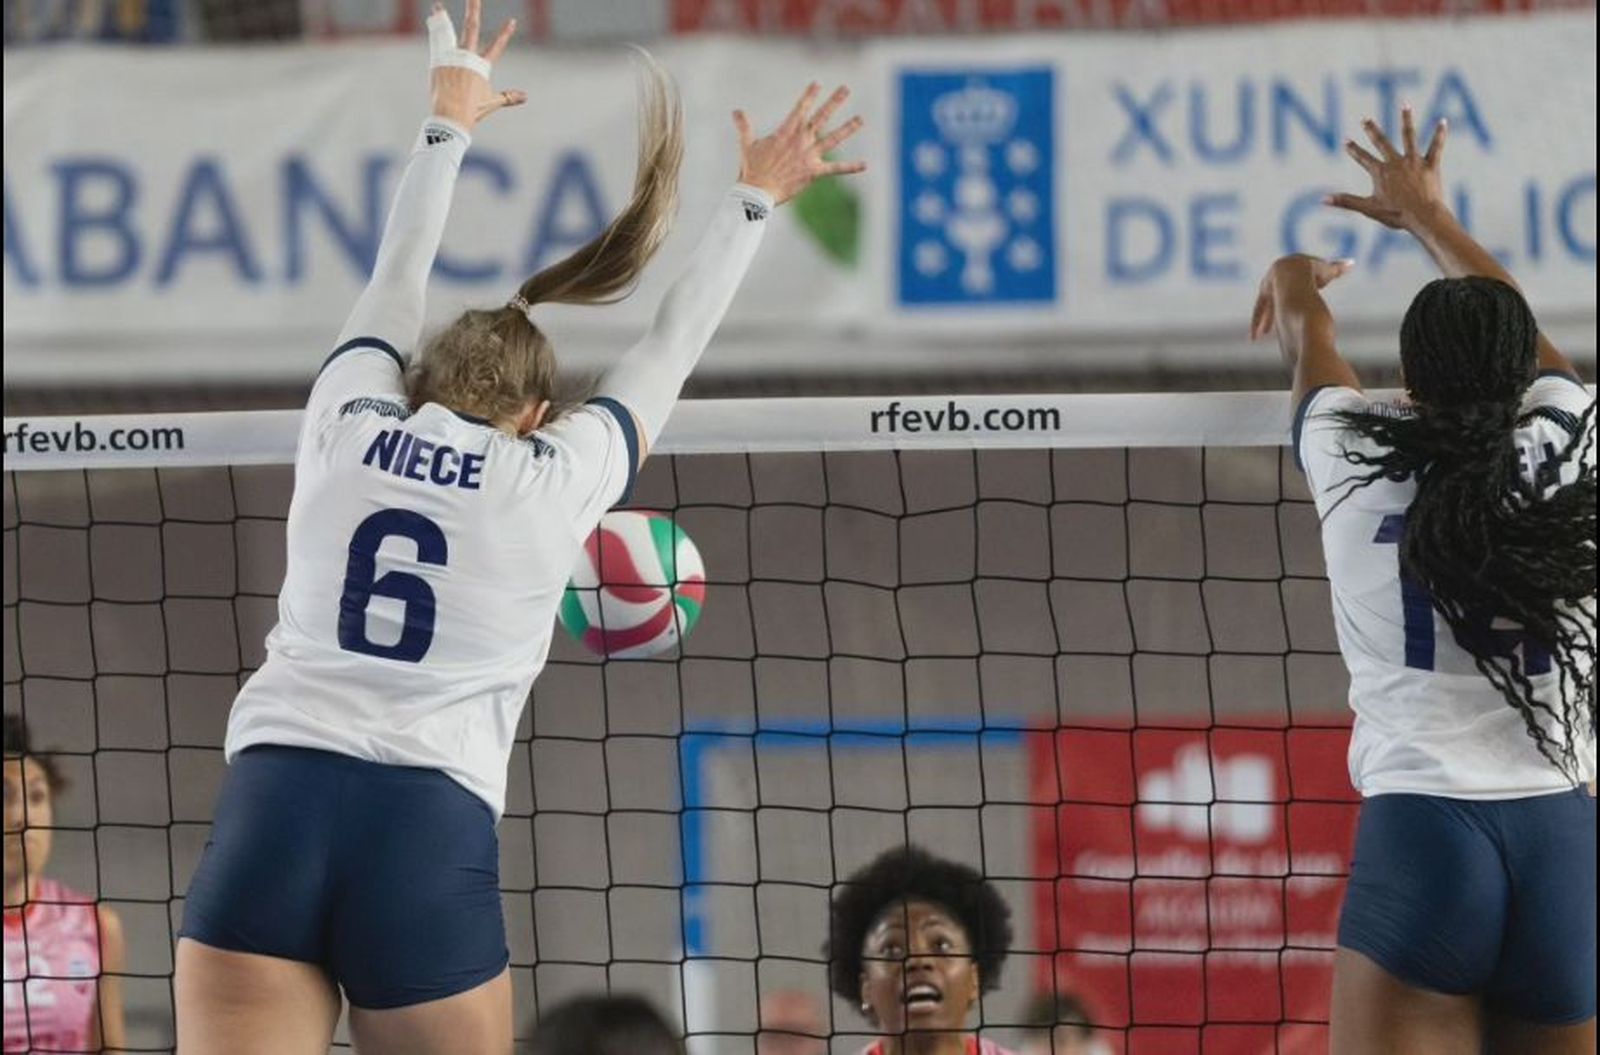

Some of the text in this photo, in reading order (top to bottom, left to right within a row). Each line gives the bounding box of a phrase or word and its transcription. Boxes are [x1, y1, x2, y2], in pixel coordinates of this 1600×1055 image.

[1108, 70, 1494, 165] XUNTA
[1104, 190, 1248, 283] DE
[4, 422, 184, 453] rfevb.com
[870, 401, 1061, 433] rfevb.com
[362, 429, 486, 490] NIECE
[337, 507, 448, 664] 6
